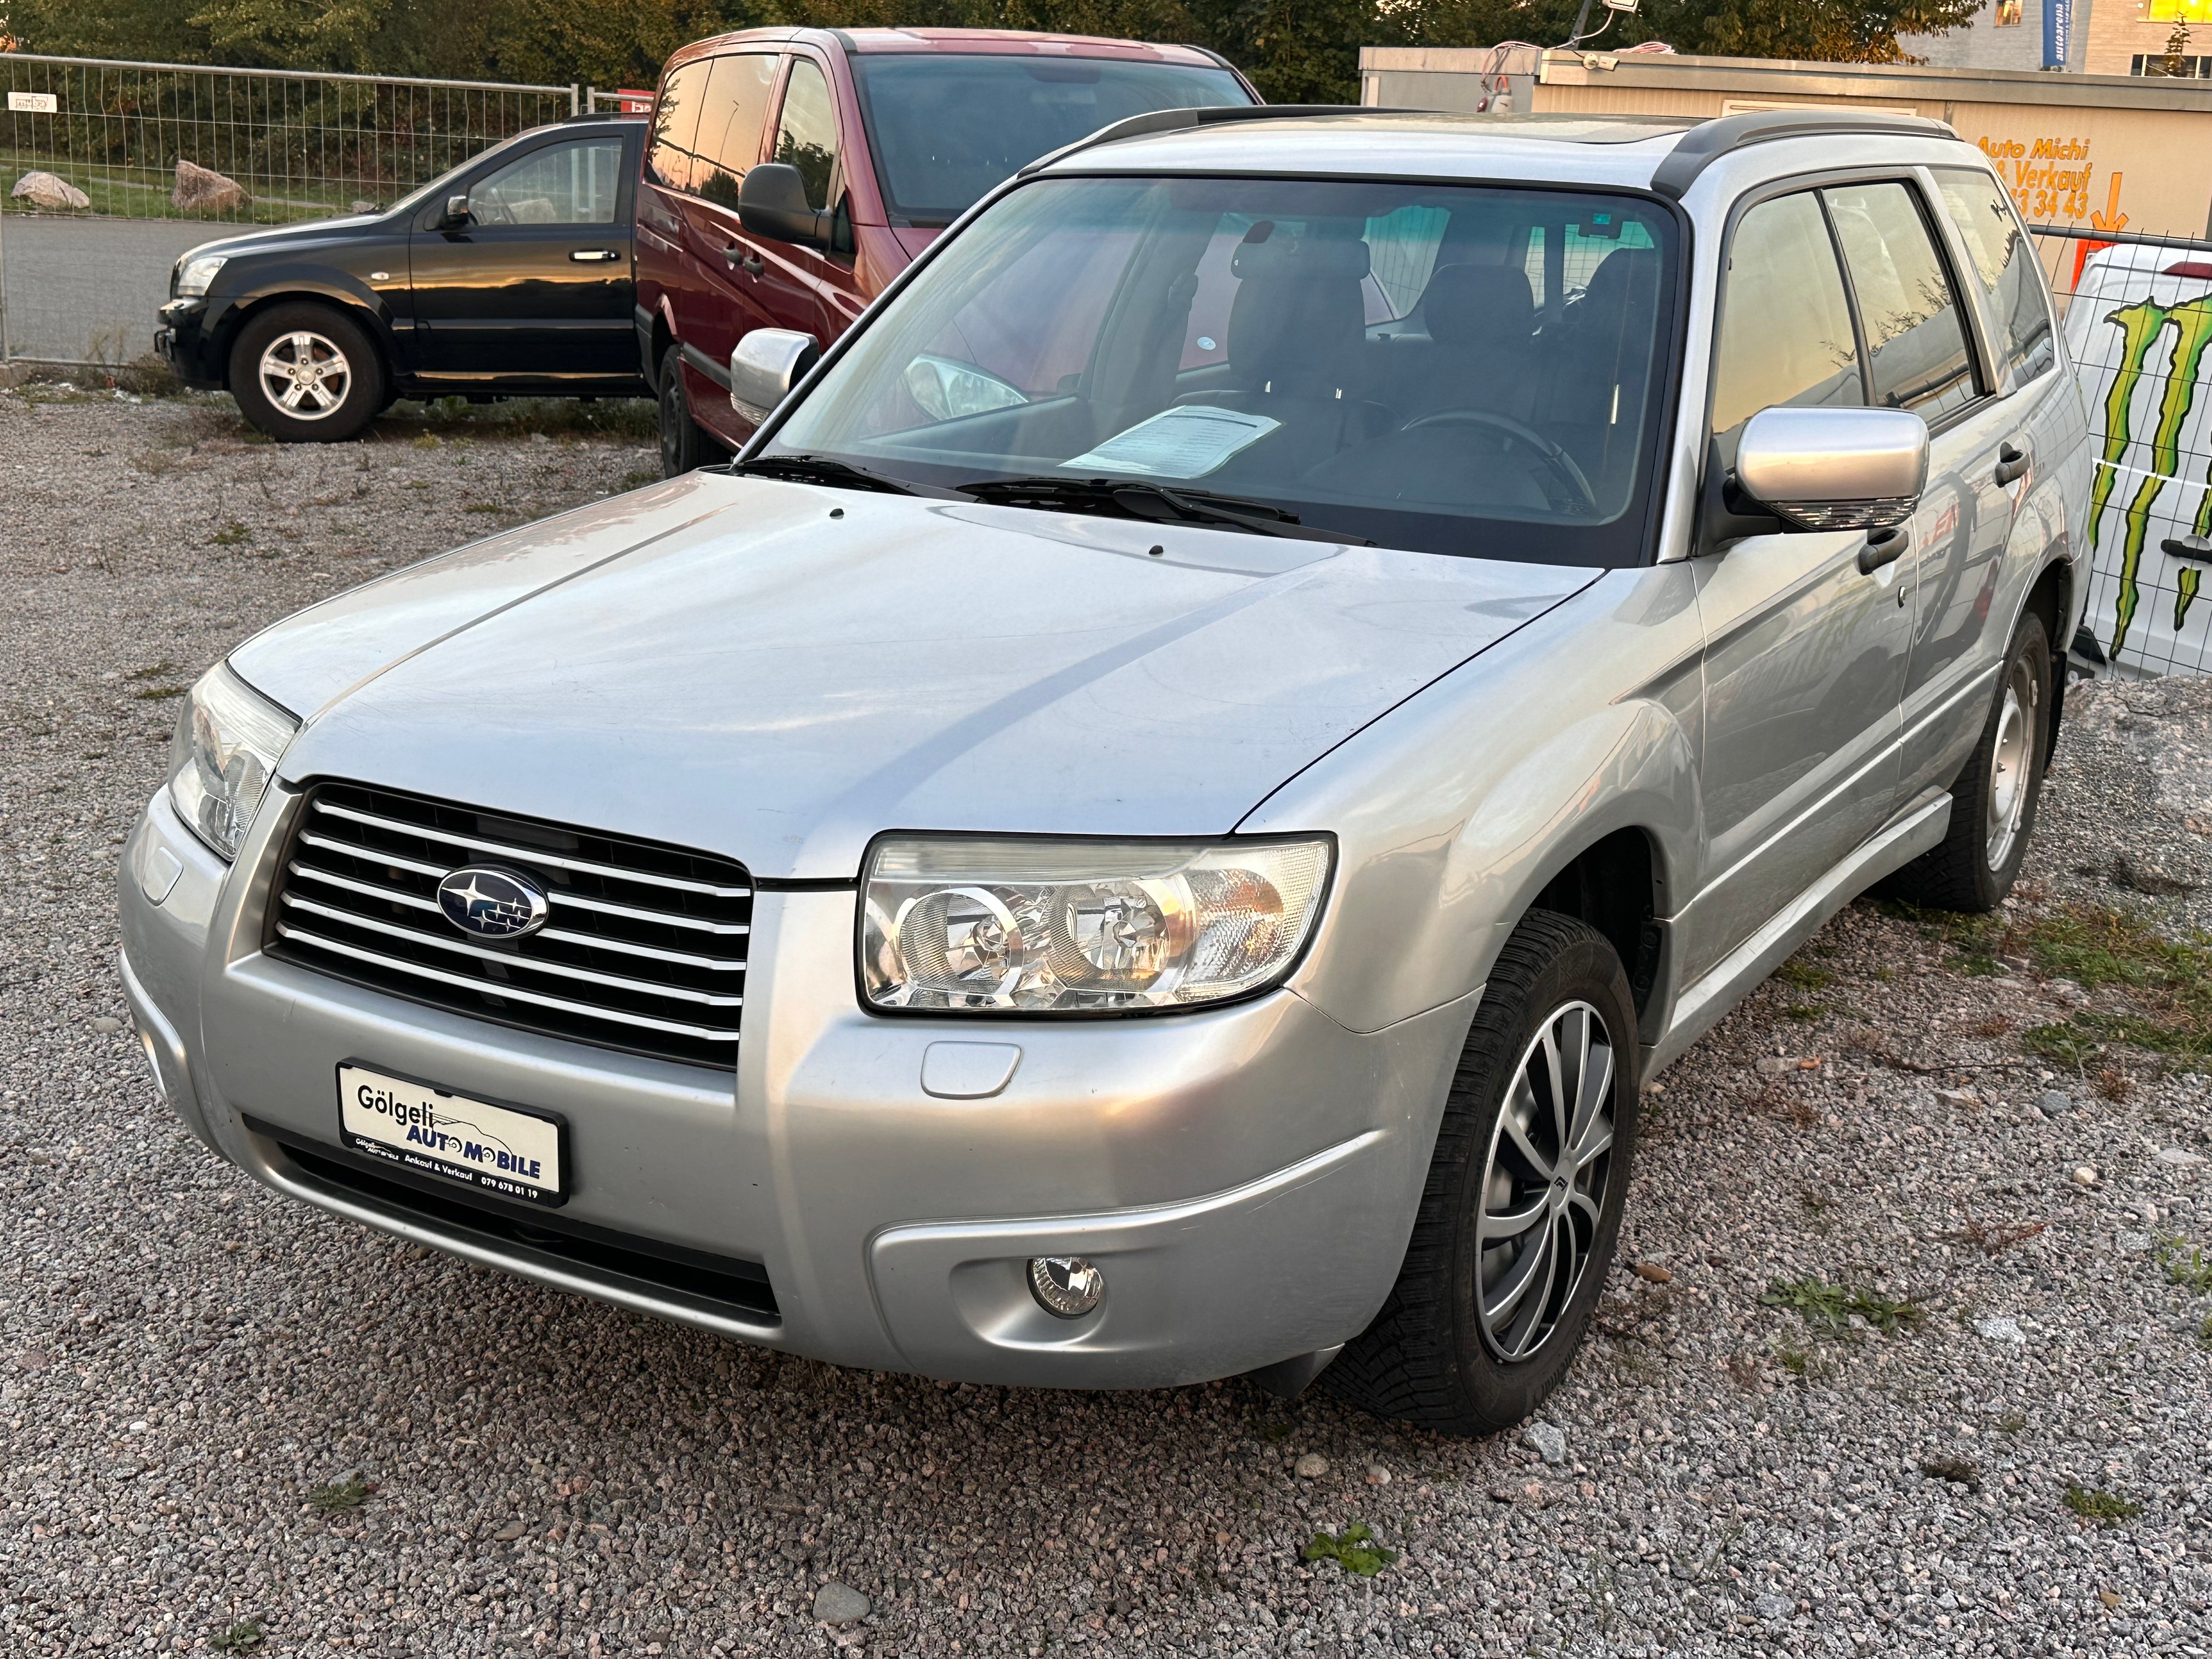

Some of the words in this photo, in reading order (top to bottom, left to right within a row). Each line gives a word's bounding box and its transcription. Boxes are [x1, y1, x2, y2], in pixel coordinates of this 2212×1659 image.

[1977, 137, 2025, 158] Auto
[2030, 138, 2090, 160] Michi
[2015, 161, 2092, 191] Verkauf
[2033, 190, 2058, 217] 34
[2063, 191, 2089, 219] 43
[358, 1085, 433, 1127] Gölgeli
[434, 1163, 441, 1171] &
[481, 1177, 496, 1187] 079
[498, 1181, 513, 1192] 678
[515, 1186, 524, 1195] 01
[528, 1189, 538, 1199] 19
